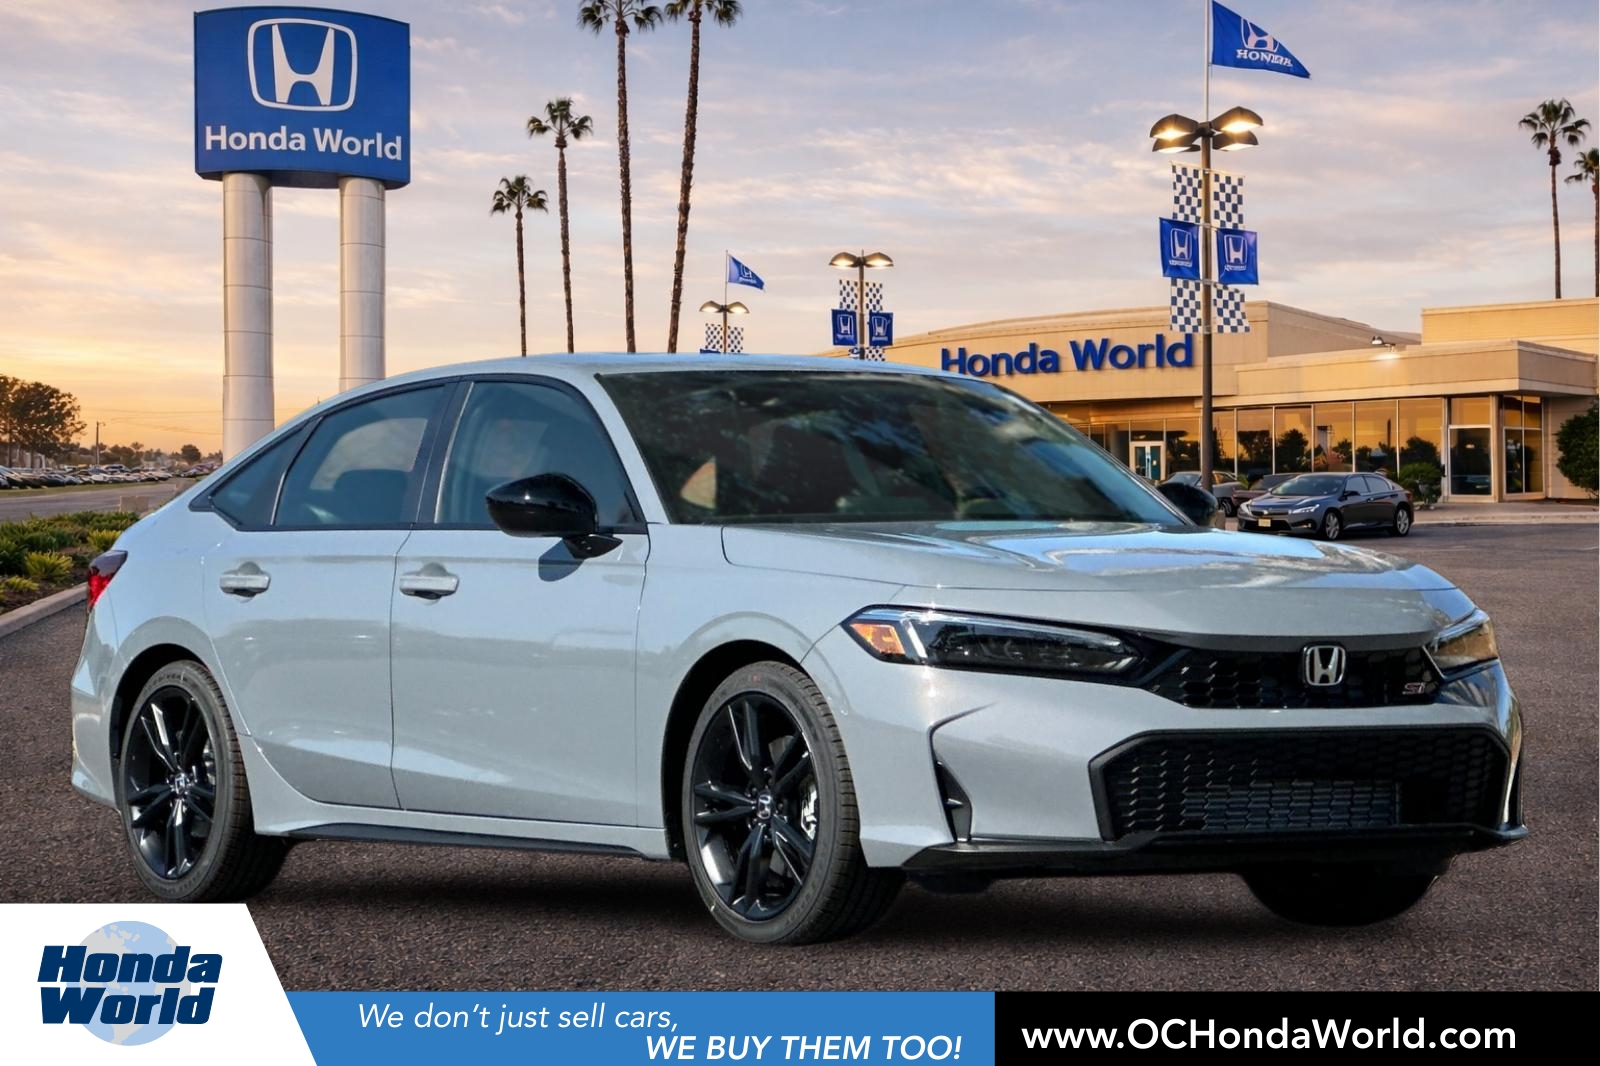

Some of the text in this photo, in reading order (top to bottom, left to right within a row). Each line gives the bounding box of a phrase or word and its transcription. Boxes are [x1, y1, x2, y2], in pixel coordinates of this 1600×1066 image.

[205, 125, 402, 160] Honda World
[941, 333, 1194, 377] Honda World
[1402, 682, 1426, 695] Si
